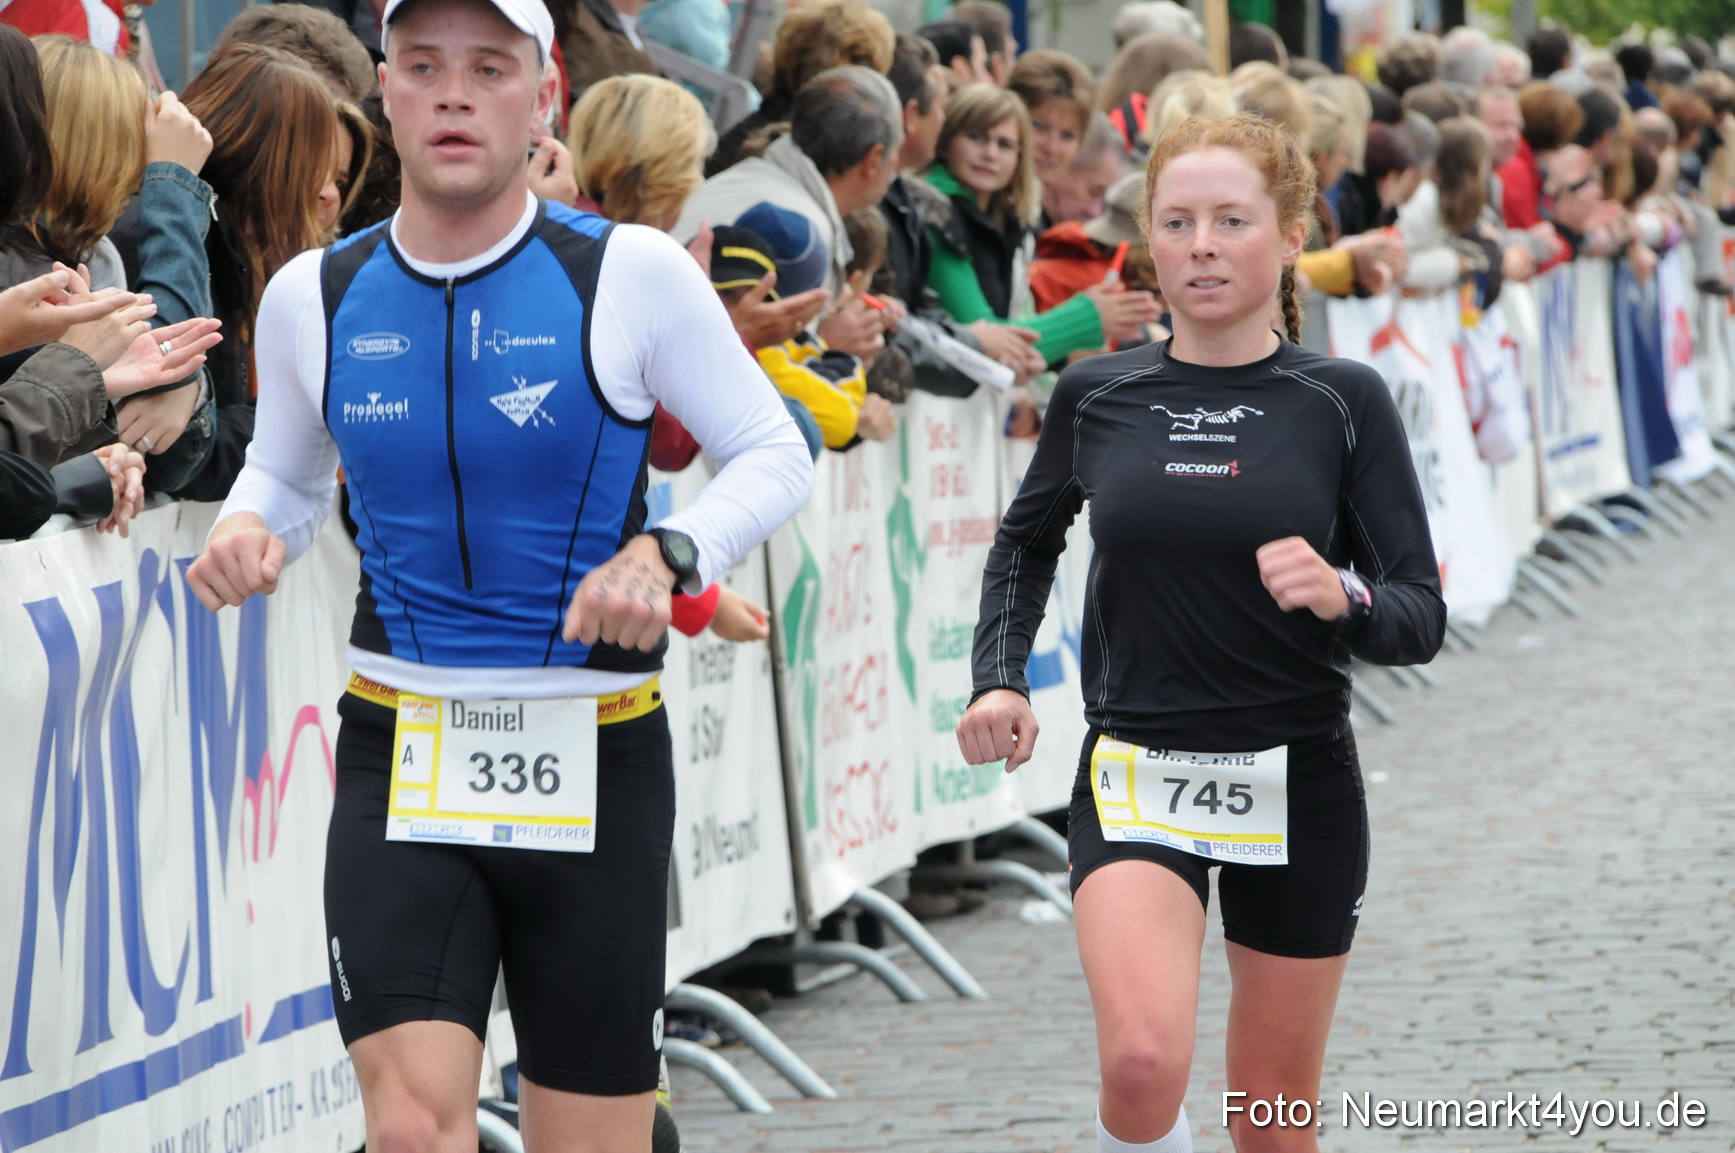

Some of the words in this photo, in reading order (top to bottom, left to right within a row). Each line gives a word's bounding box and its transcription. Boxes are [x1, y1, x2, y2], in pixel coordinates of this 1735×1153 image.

[1168, 434, 1237, 443] WECHSELSZENE
[597, 694, 637, 714] werBar
[450, 699, 525, 732] Daniel
[402, 743, 415, 766] A
[468, 752, 561, 795] 336
[1100, 770, 1112, 790] A
[1163, 777, 1254, 816] 745
[514, 823, 591, 842] PFLEIDERER
[1212, 842, 1284, 857] PFLEIDERER
